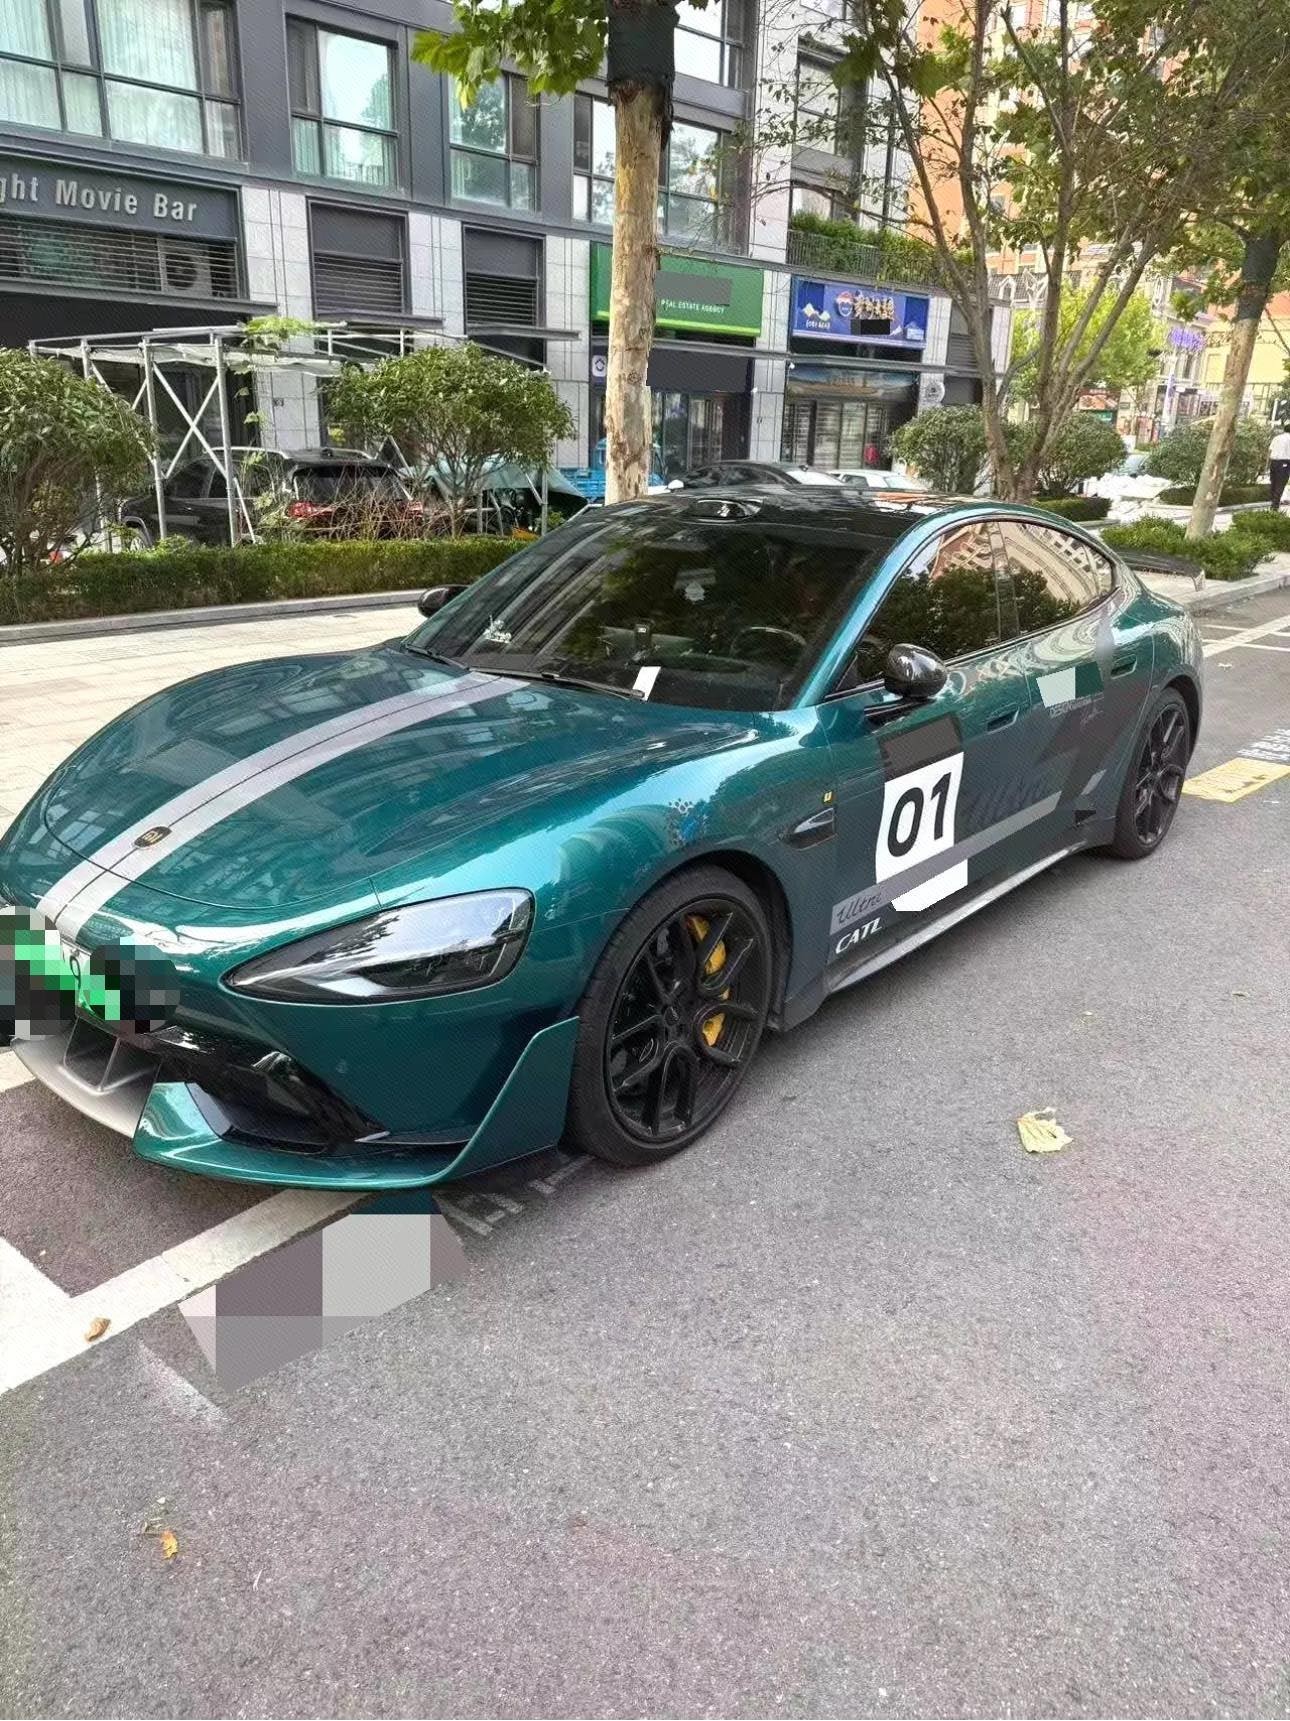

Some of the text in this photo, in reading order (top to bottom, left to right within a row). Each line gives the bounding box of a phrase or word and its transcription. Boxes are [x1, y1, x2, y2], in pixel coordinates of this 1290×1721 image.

[55, 179, 138, 215] Movie
[153, 192, 197, 221] Bar
[887, 771, 952, 858] 01
[835, 917, 883, 954] CATL
